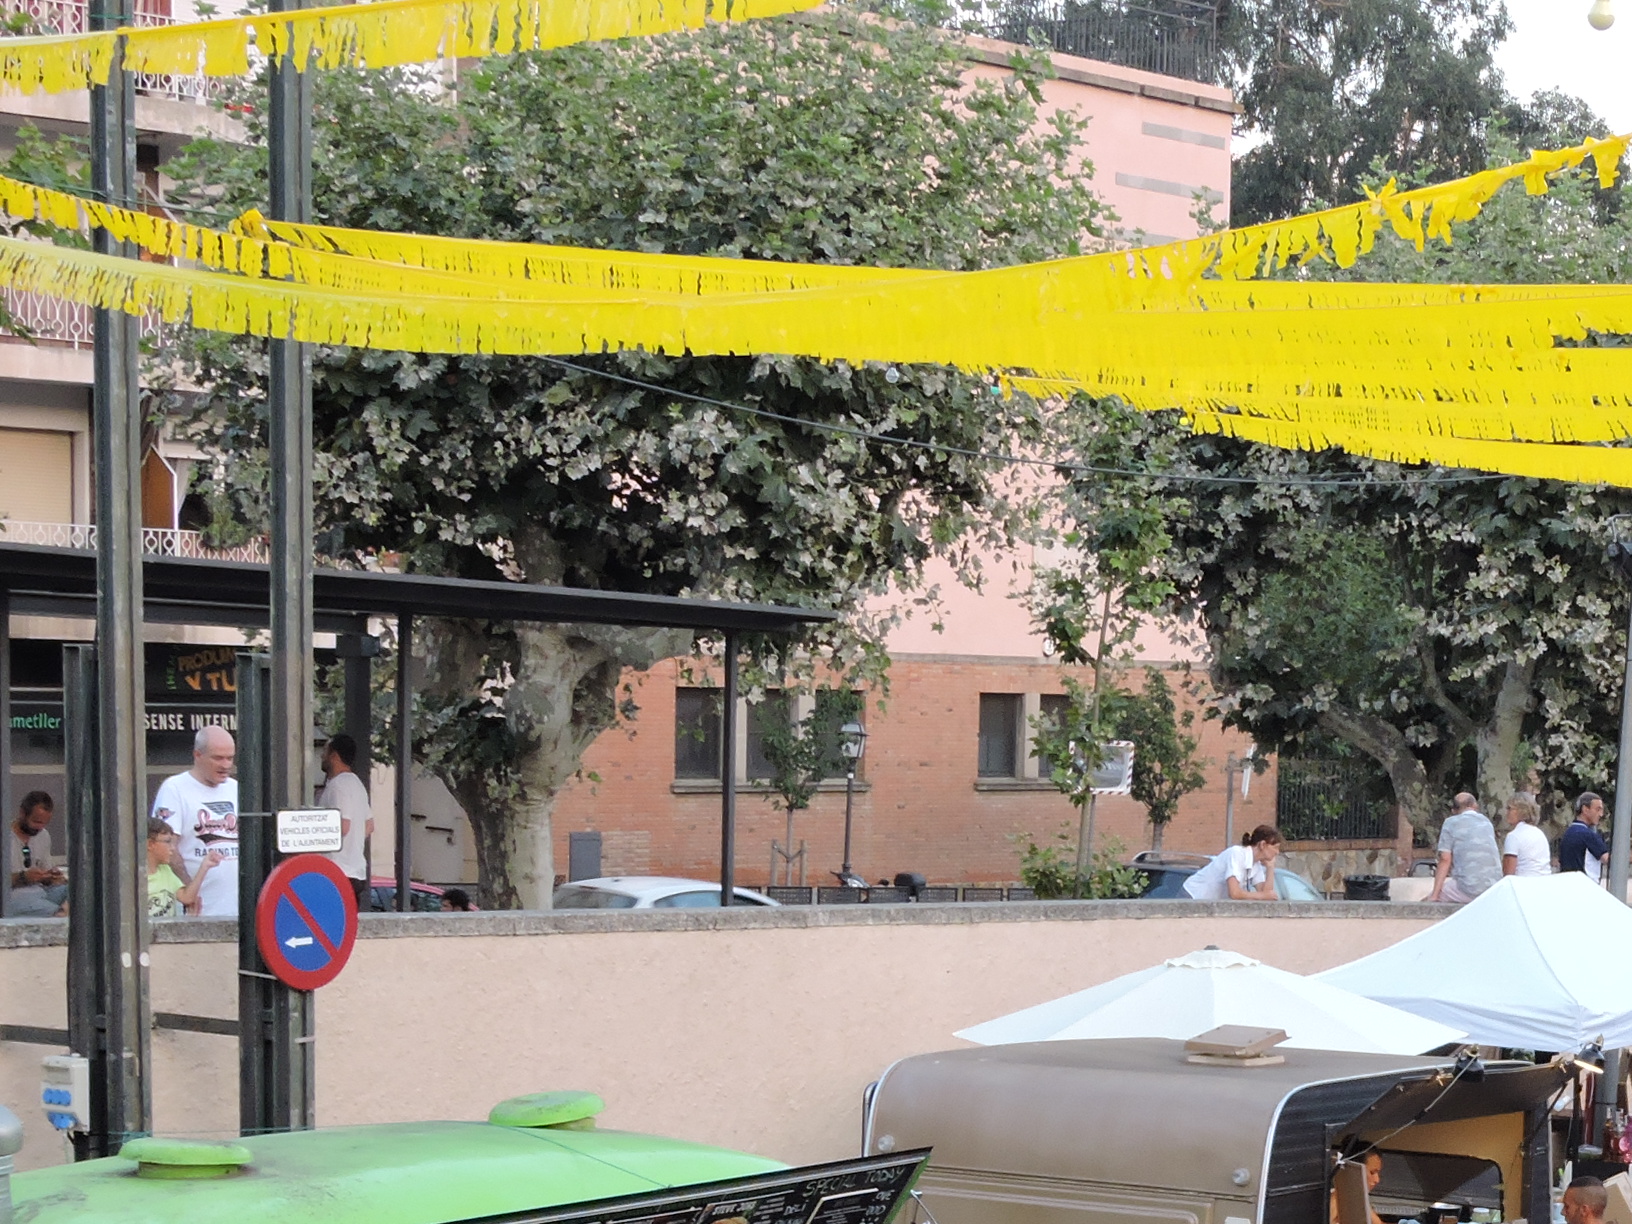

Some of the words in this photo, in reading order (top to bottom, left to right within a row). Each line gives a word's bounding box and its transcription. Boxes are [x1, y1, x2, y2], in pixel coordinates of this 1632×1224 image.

[9, 713, 61, 729] metller
[145, 713, 185, 730] SENSE
[290, 814, 328, 823] AUTORITZAT
[280, 827, 310, 836] VEHICLES
[311, 826, 340, 834] OFICIALS
[281, 839, 291, 848] DE
[803, 1176, 857, 1198] SPECIAL
[863, 1166, 906, 1185] TODAY
